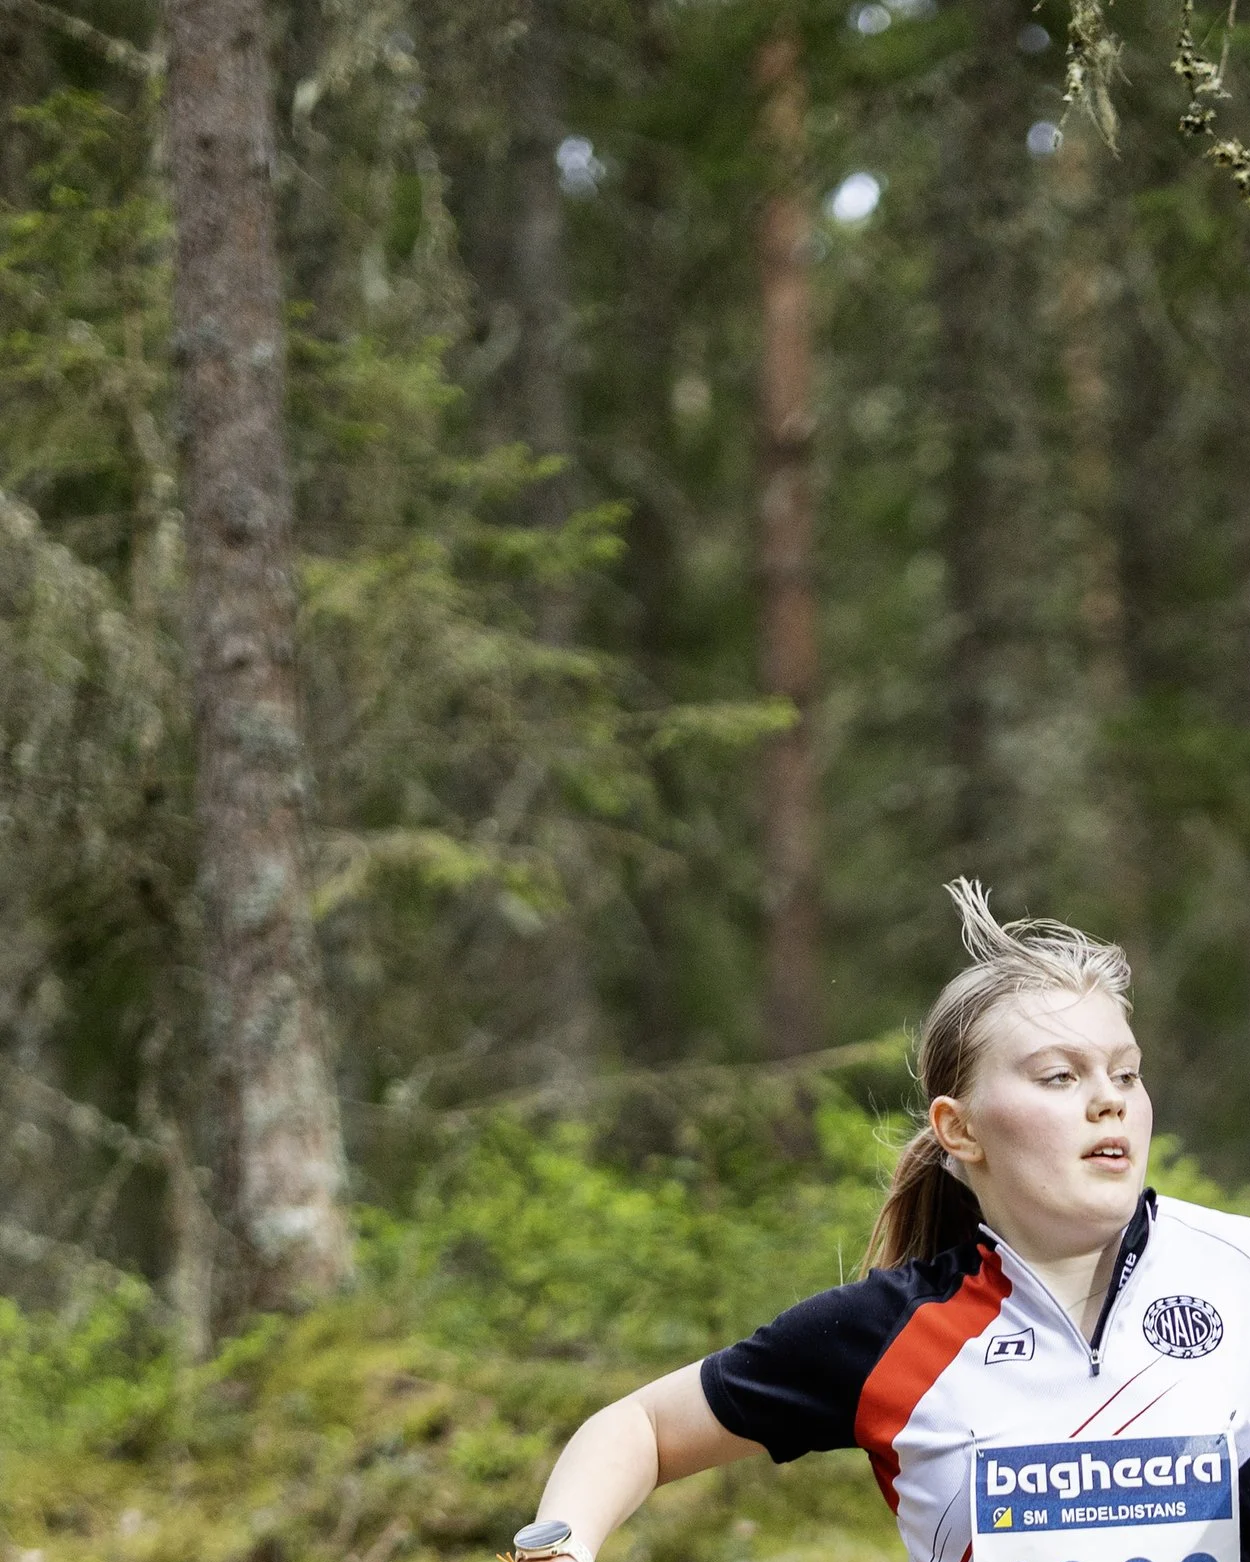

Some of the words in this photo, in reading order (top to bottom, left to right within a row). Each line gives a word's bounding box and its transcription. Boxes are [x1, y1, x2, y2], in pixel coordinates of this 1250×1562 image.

[1160, 1305, 1208, 1347] NAIS
[986, 1451, 1222, 1499] bagheera
[1023, 1510, 1048, 1525] SM
[1061, 1501, 1187, 1523] MEDELDISTANS
